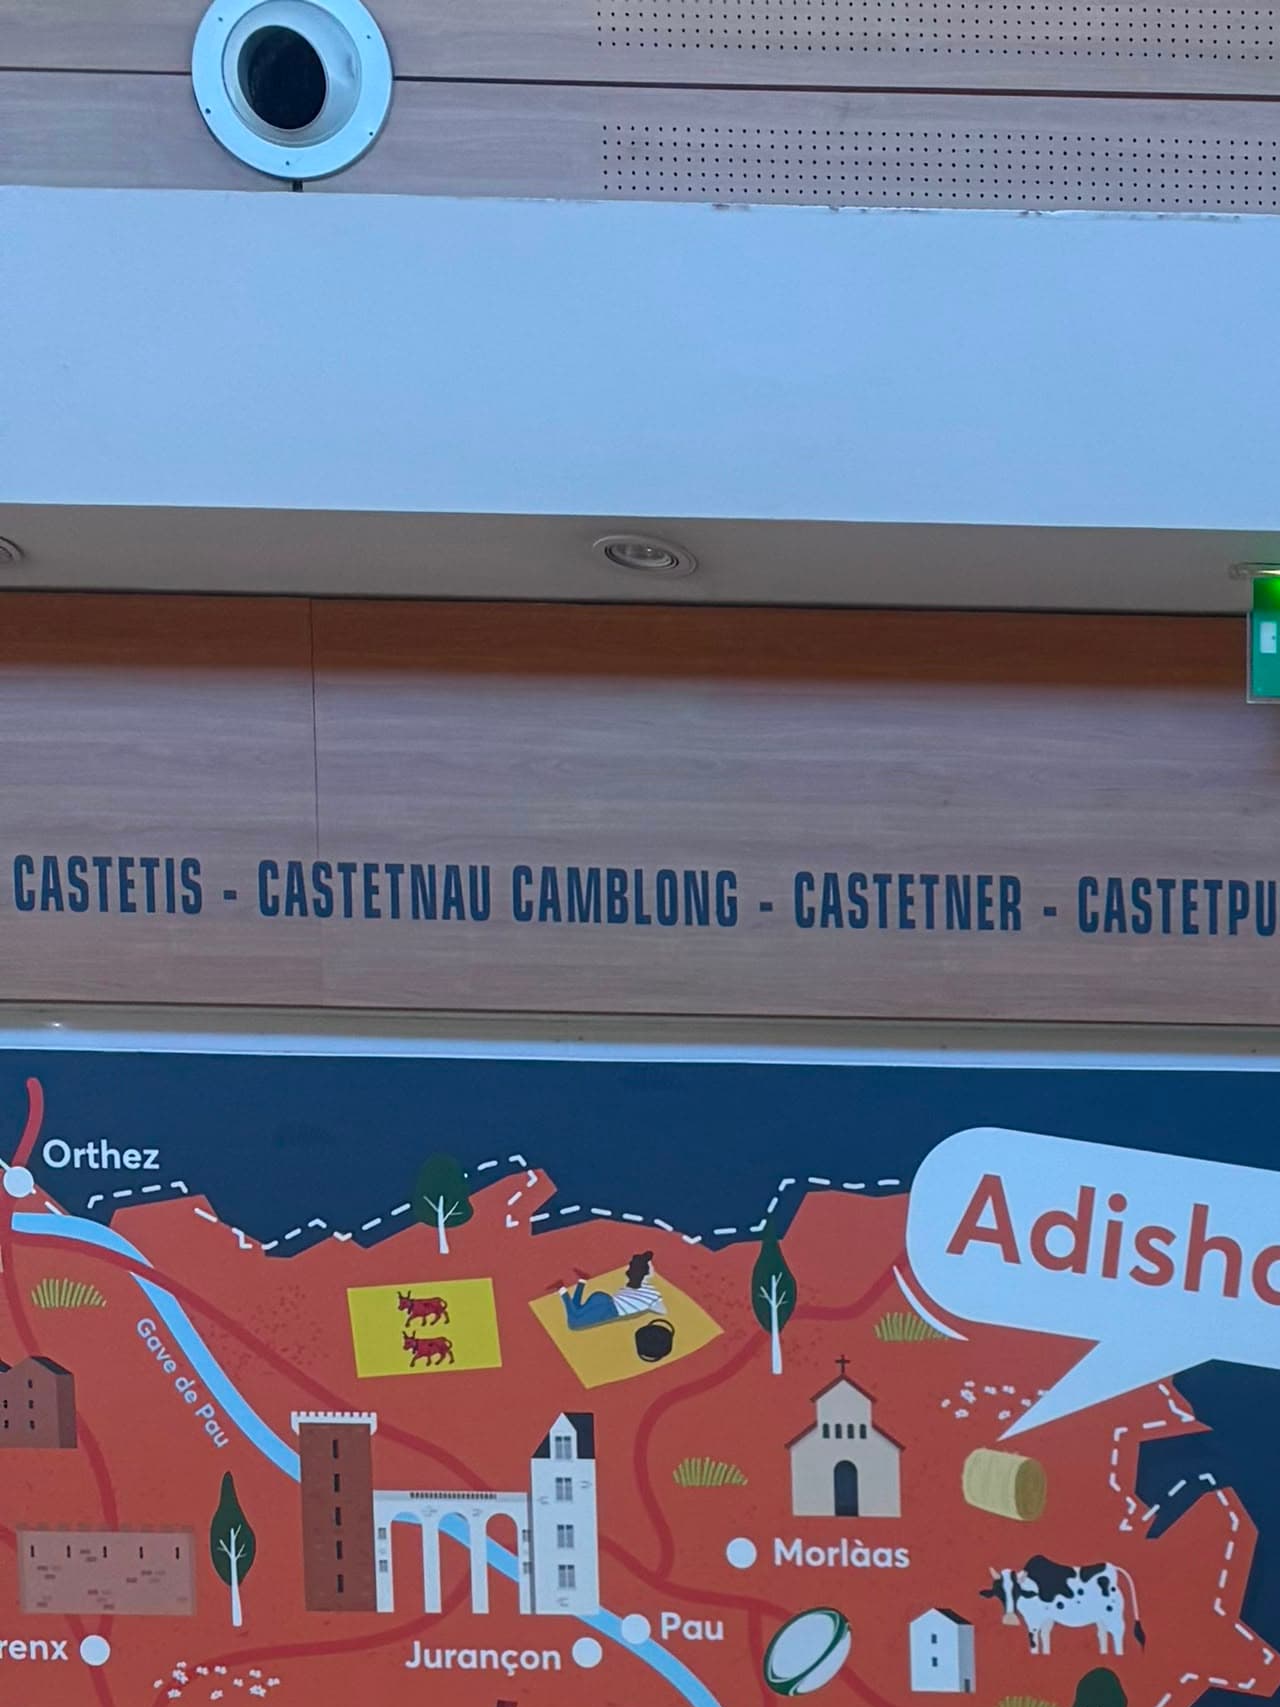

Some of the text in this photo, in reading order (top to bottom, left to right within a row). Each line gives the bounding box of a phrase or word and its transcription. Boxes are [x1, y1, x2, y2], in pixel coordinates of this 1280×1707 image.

[14, 855, 202, 915] CASTETIS
[258, 860, 491, 921] CASTETNAU
[513, 865, 738, 927] CAMBLONG
[795, 872, 1022, 931] CASTETNER
[42, 1138, 160, 1170] Orthez
[137, 1318, 229, 1447] Gave de Pau
[773, 1537, 911, 1570] Morlàas
[660, 1611, 724, 1641] Pau
[405, 1640, 561, 1676] Jurançon
